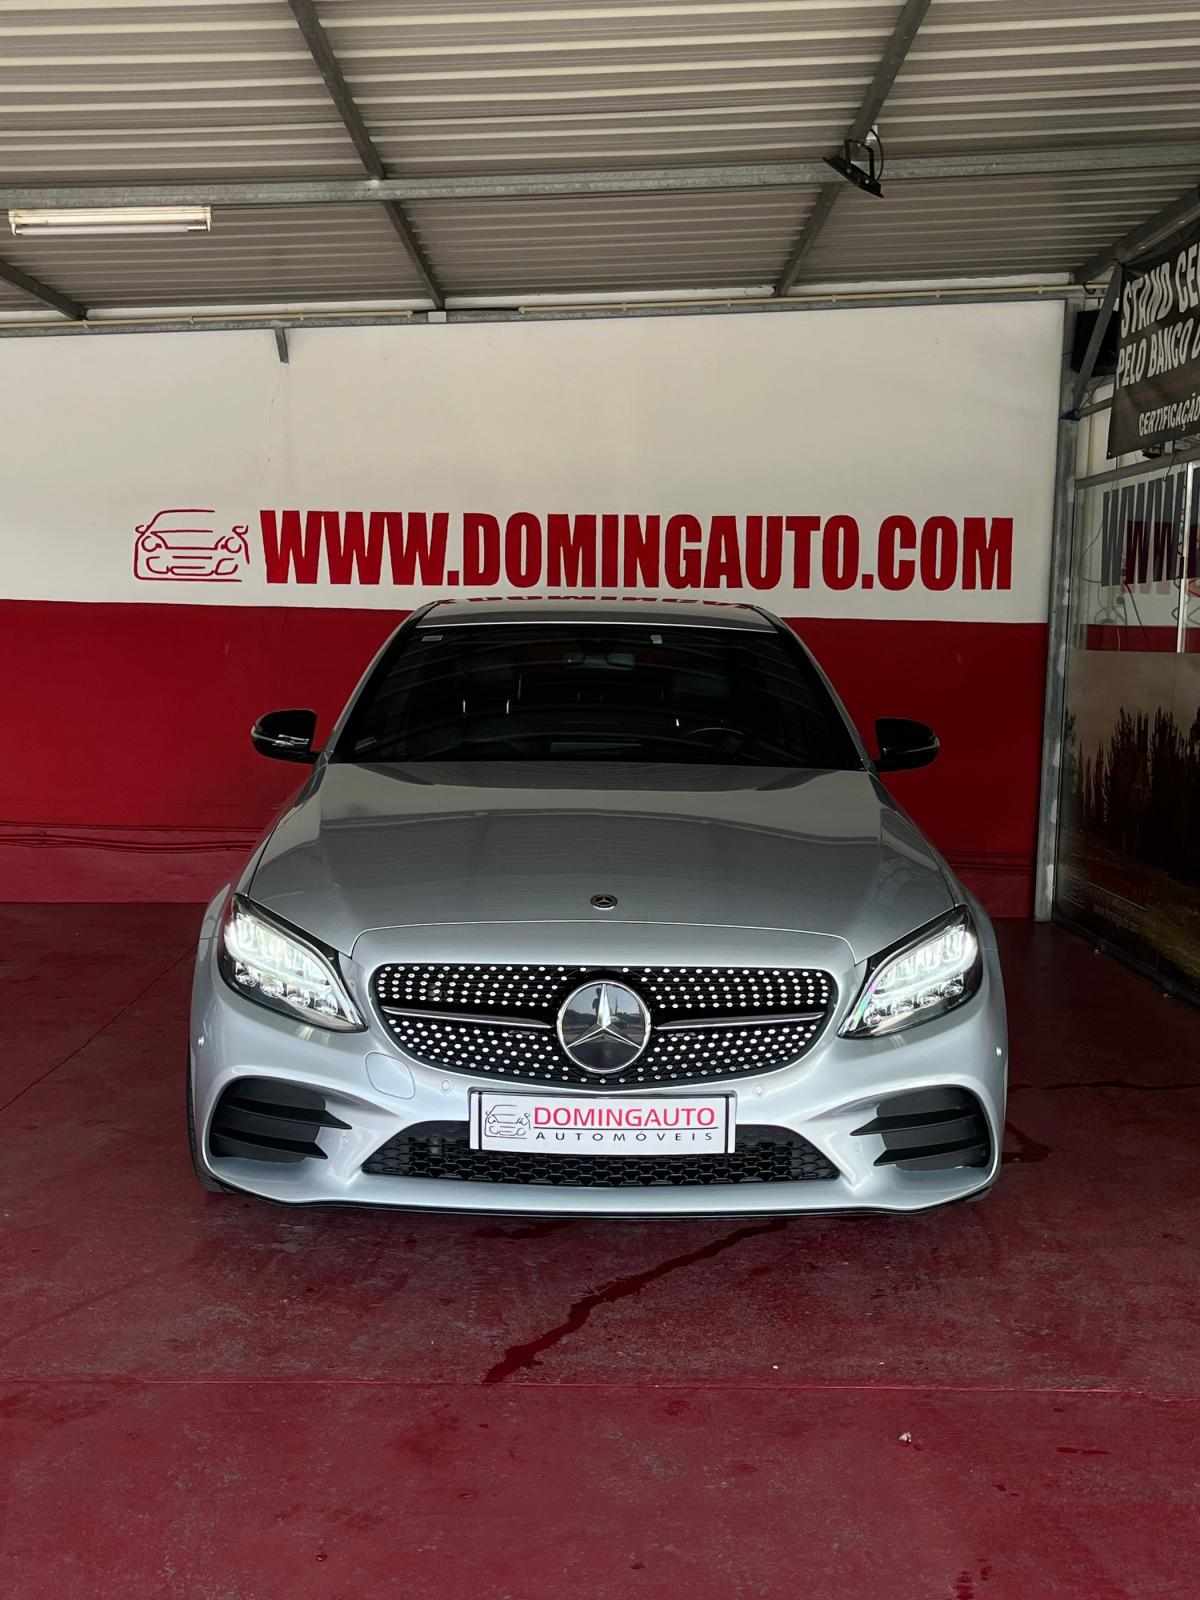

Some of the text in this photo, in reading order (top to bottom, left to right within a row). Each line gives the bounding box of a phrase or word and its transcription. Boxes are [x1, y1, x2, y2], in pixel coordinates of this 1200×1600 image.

[1121, 261, 1174, 339] STAND
[1174, 241, 1200, 314] CE
[1116, 337, 1146, 391] PELO
[1147, 317, 1194, 379] BANCO
[260, 510, 1014, 591] WWW.DOMINGAUTO.COM
[534, 1106, 716, 1128] DOMINGAUTO
[535, 1130, 713, 1142] AUTOMÓVEIS
